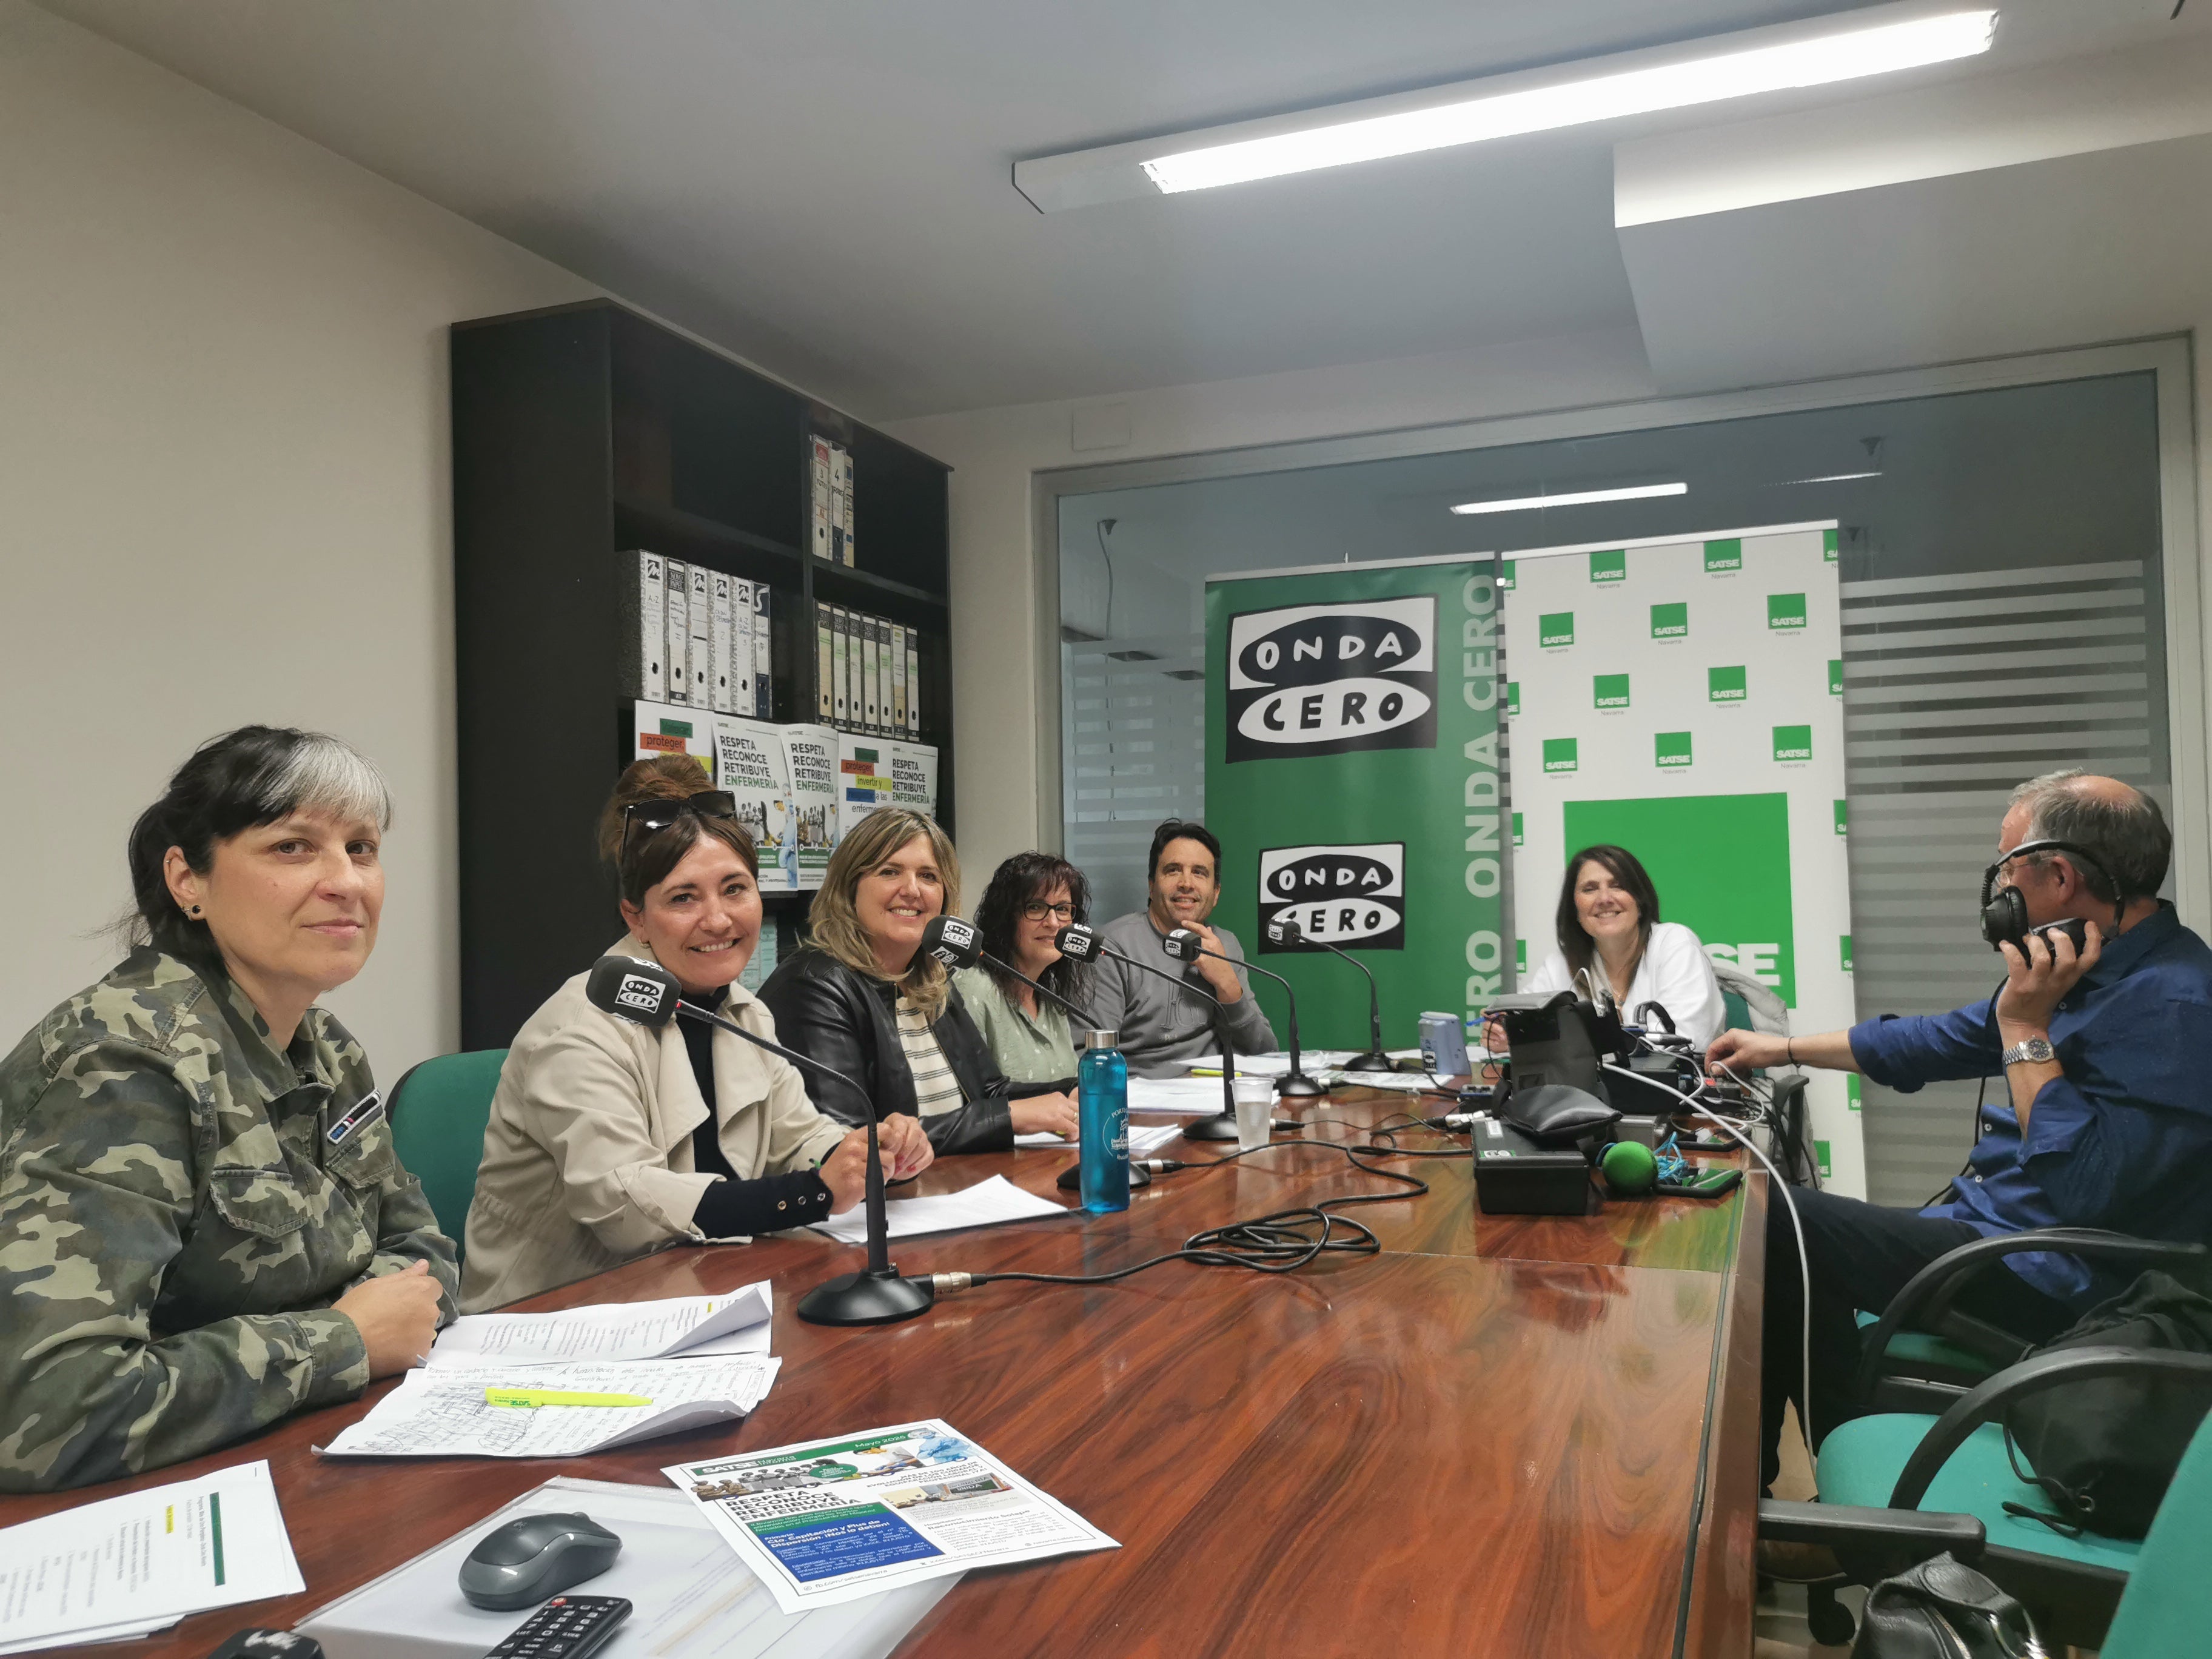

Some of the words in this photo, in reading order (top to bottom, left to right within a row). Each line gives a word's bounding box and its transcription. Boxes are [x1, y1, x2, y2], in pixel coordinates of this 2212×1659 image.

[1708, 558, 1740, 569] SATSE
[1592, 569, 1624, 580] SATSE
[1771, 617, 1805, 626] SATSE
[1654, 626, 1686, 636] SATSE
[1463, 575, 1498, 711] CERO
[1542, 635, 1572, 645] SATSE
[1256, 632, 1403, 669] ONDA
[1712, 689, 1744, 699] SATSE
[1596, 697, 1628, 706] SATSE
[1263, 692, 1403, 731] CERO
[720, 736, 757, 751] RESPETA
[791, 743, 825, 756] RESPETA
[722, 749, 768, 765] RECONOCE
[1776, 748, 1810, 759] SATSE
[793, 756, 831, 769] RECONOCE
[893, 759, 919, 771] RESPETA
[1545, 761, 1576, 771] SATSE
[1658, 755, 1690, 765] SATSE
[724, 762, 771, 777] RETRIBUYE
[795, 768, 831, 782] RETRIBUYE
[725, 775, 779, 789] ENFERMERÍA
[857, 776, 878, 786] invertir
[879, 780, 882, 789] y
[893, 770, 926, 783] RECONOCE
[893, 782, 927, 794] RETRIBUYE
[876, 792, 879, 800] a
[893, 793, 930, 804] ENFERMERÍA
[852, 804, 877, 814] enferme
[1464, 730, 1501, 897] ONDA
[1279, 867, 1381, 890] ONDA
[949, 925, 969, 936] ONDA
[948, 934, 967, 943] CERO
[628, 982, 657, 994] ONDA
[625, 994, 653, 1005] CERO
[855, 1439, 881, 1448] Mayo
[702, 1461, 758, 1473] SATSE
[726, 1490, 810, 1507] RESPETA
[730, 1492, 839, 1512] RECONOCE
[735, 1496, 842, 1516] RETRIBUYE
[739, 1499, 862, 1521] ENFERMERÍA
[927, 1515, 999, 1529] Reconocimiento
[786, 1527, 839, 1540] Capitación
